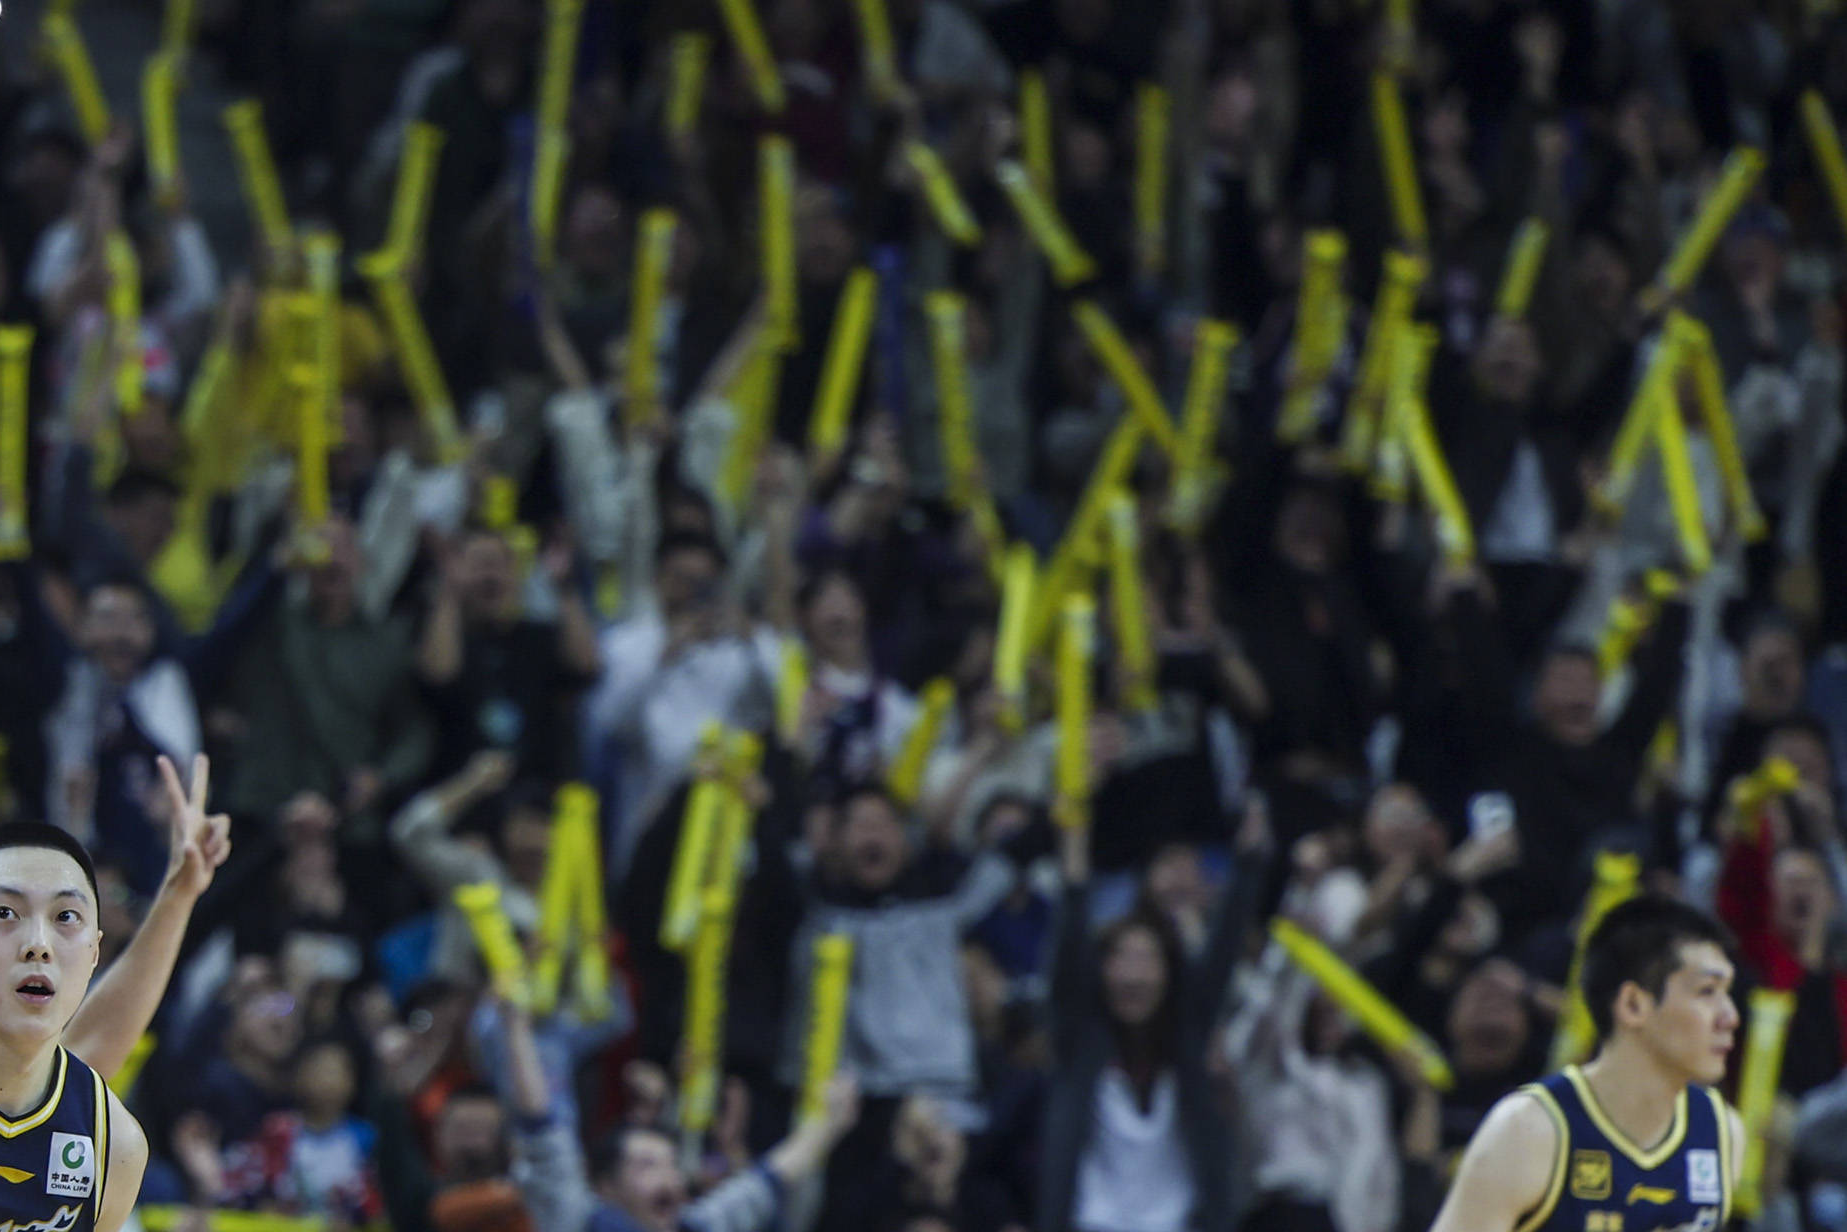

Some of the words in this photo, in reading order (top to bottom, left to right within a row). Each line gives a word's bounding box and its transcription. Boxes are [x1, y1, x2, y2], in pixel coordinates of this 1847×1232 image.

[51, 1173, 90, 1185] 中国人寿
[51, 1183, 71, 1191] CHINA
